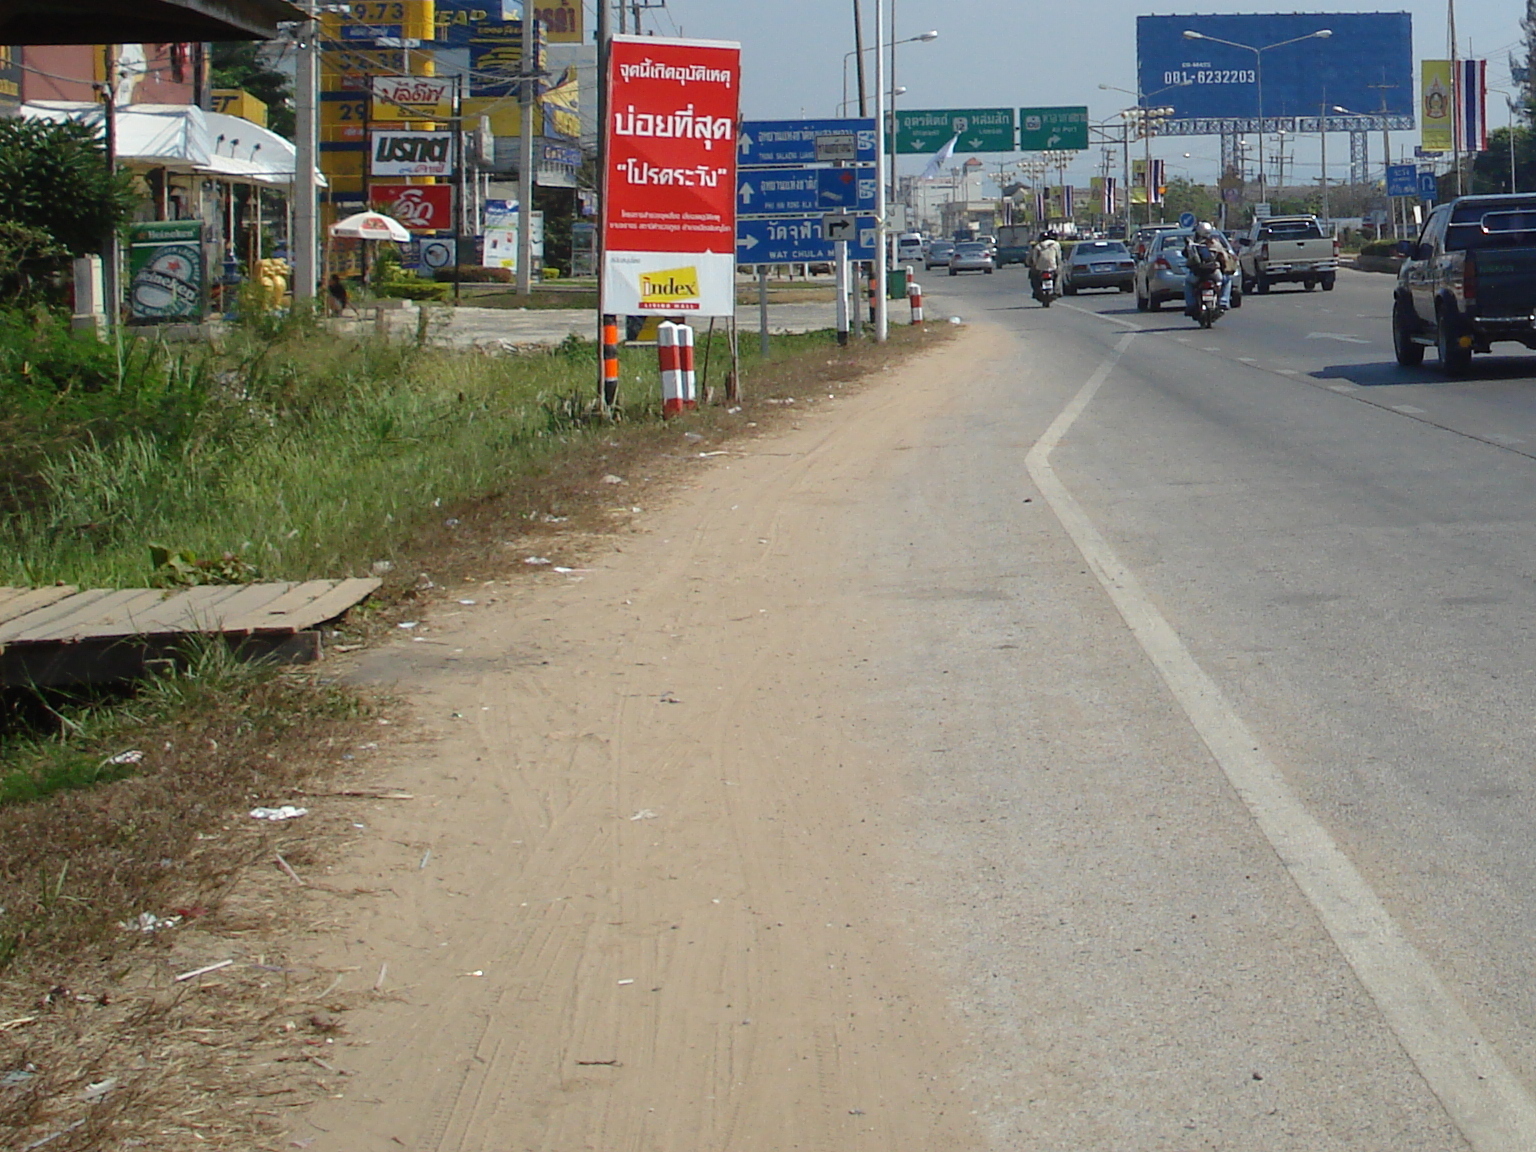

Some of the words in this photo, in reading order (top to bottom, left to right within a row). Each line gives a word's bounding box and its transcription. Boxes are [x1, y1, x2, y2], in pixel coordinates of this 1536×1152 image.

[620, 57, 731, 88] จุดนี้เกิดอุบัติเหตุ
[615, 103, 732, 151] บ่อยที่สุด
[643, 276, 696, 297] index
